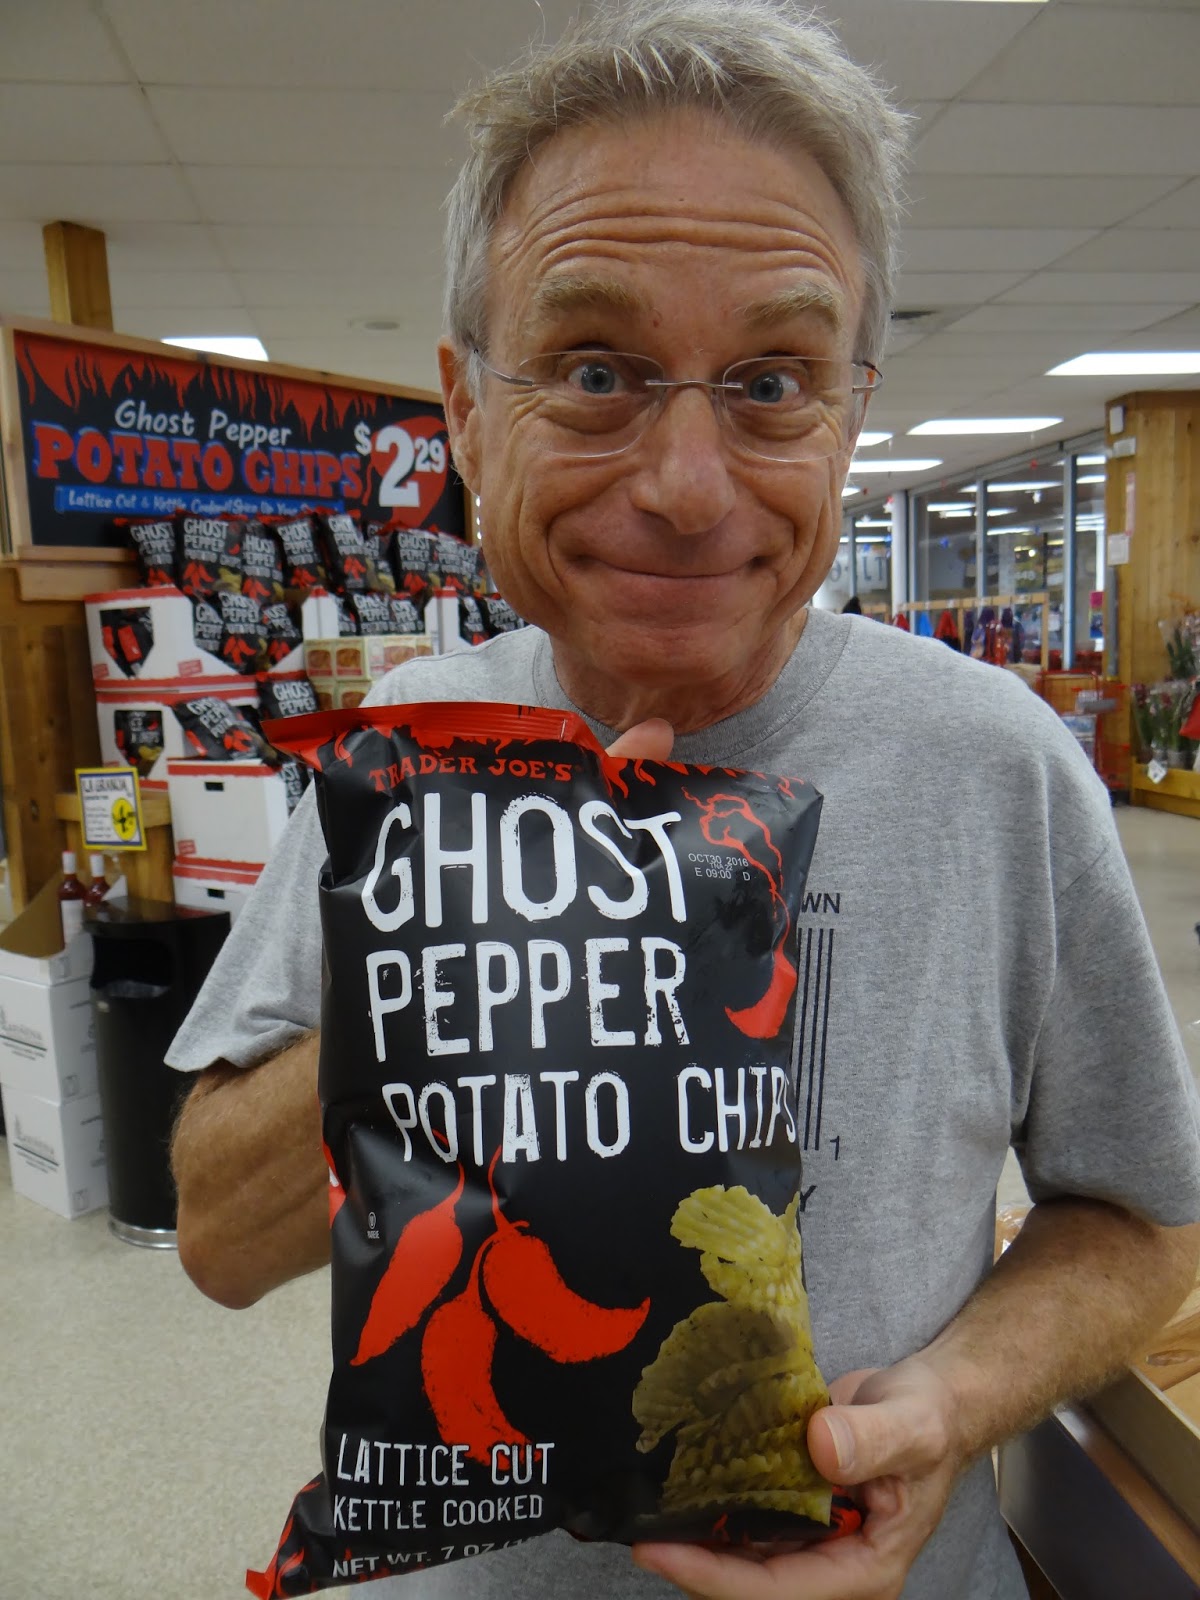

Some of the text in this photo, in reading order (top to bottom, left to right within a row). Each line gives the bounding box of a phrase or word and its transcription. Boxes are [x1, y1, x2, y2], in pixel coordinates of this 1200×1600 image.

[114, 398, 292, 449] Ghost Pepper
[32, 420, 364, 498] POTATO CHIPS
[183, 518, 229, 539] GHOST
[368, 754, 573, 793] TRADER JOE'S
[361, 791, 688, 932] GHOST
[688, 853, 722, 864] OCT30
[694, 867, 751, 881] E 09:00 D
[366, 937, 691, 1064] PEPPER
[382, 1064, 797, 1167] POTATO CHIPS
[336, 1433, 556, 1487] LATTICE CUT
[333, 1494, 544, 1532] KETTLE COOKED
[332, 1555, 380, 1578] NET
[441, 1545, 455, 1560] 7
